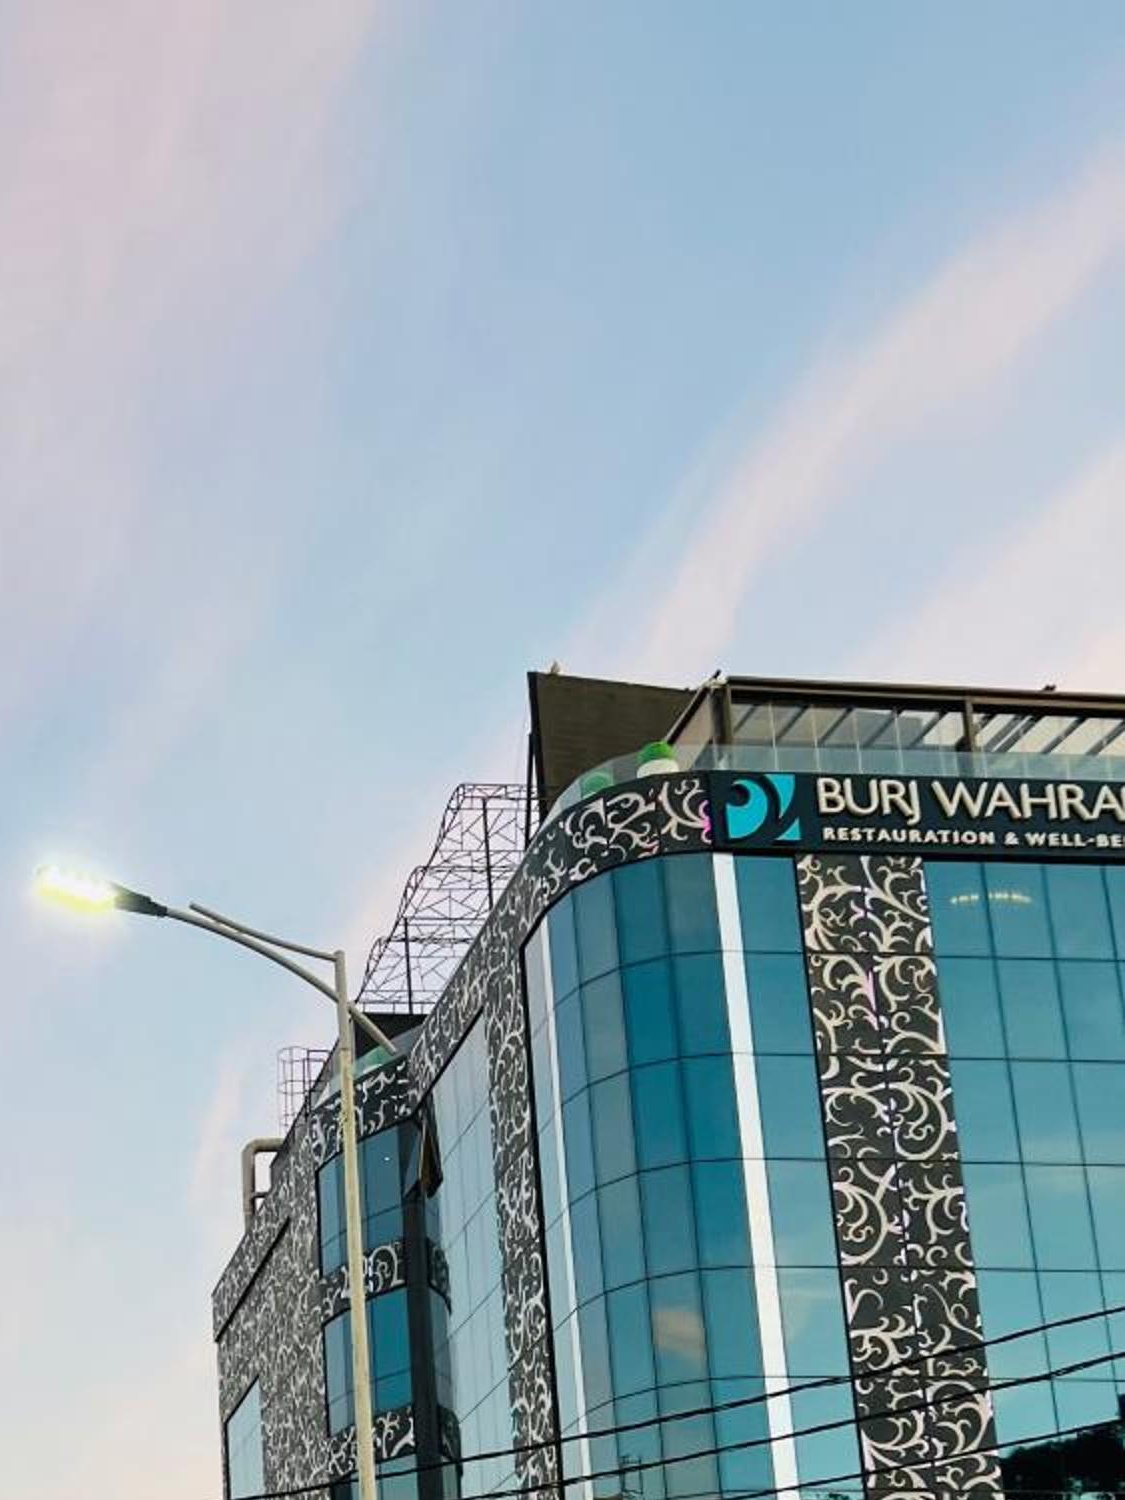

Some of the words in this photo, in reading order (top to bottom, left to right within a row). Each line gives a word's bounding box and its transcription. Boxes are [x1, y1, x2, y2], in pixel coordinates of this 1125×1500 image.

[817, 778, 920, 826] BURJ
[931, 781, 1125, 821] WAHRA
[822, 827, 995, 845] RESTAURATION
[1004, 831, 1019, 846] &
[1025, 832, 1125, 848] WELL-BE
